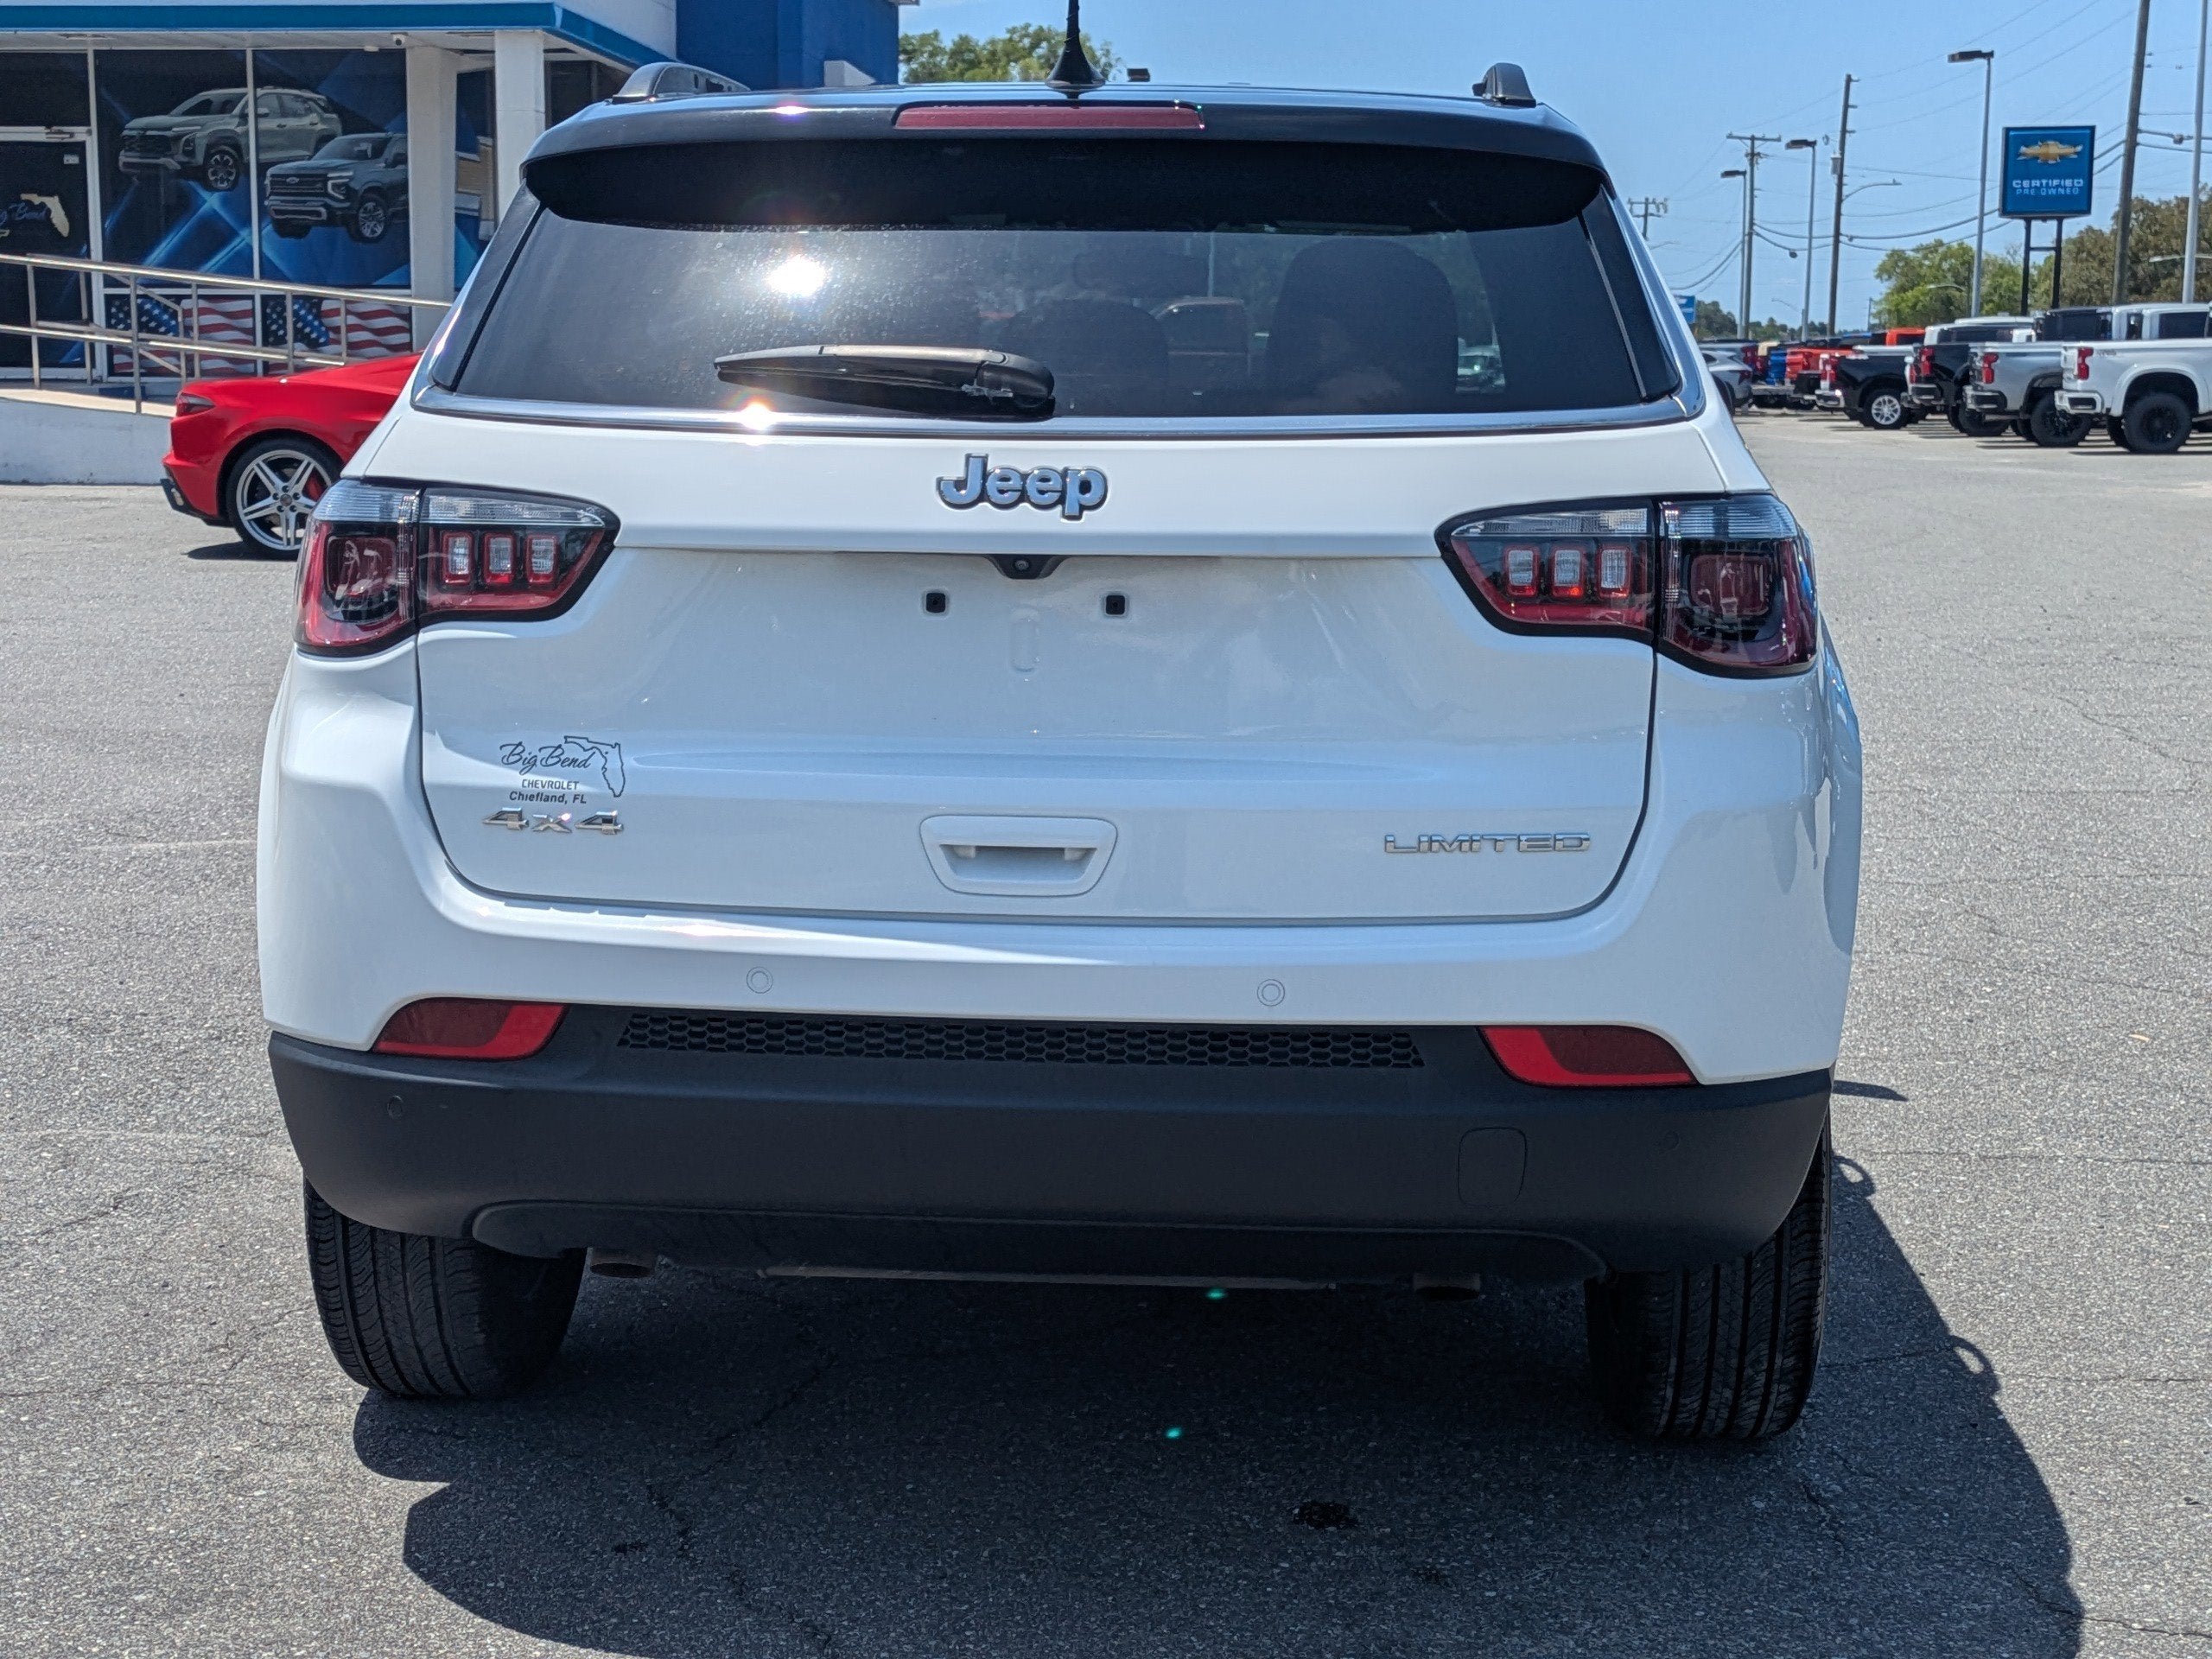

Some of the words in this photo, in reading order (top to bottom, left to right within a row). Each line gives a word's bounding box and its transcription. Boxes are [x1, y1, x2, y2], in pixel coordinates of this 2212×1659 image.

[2012, 179, 2084, 188] CERTIFIED
[936, 453, 1109, 520] Jeep
[499, 741, 537, 776] Big
[538, 744, 596, 769] Bend
[521, 779, 580, 791] CHEVROLET
[509, 791, 568, 804] Chiefland,
[572, 793, 588, 804] FL
[1384, 832, 1591, 854] LIMITED
